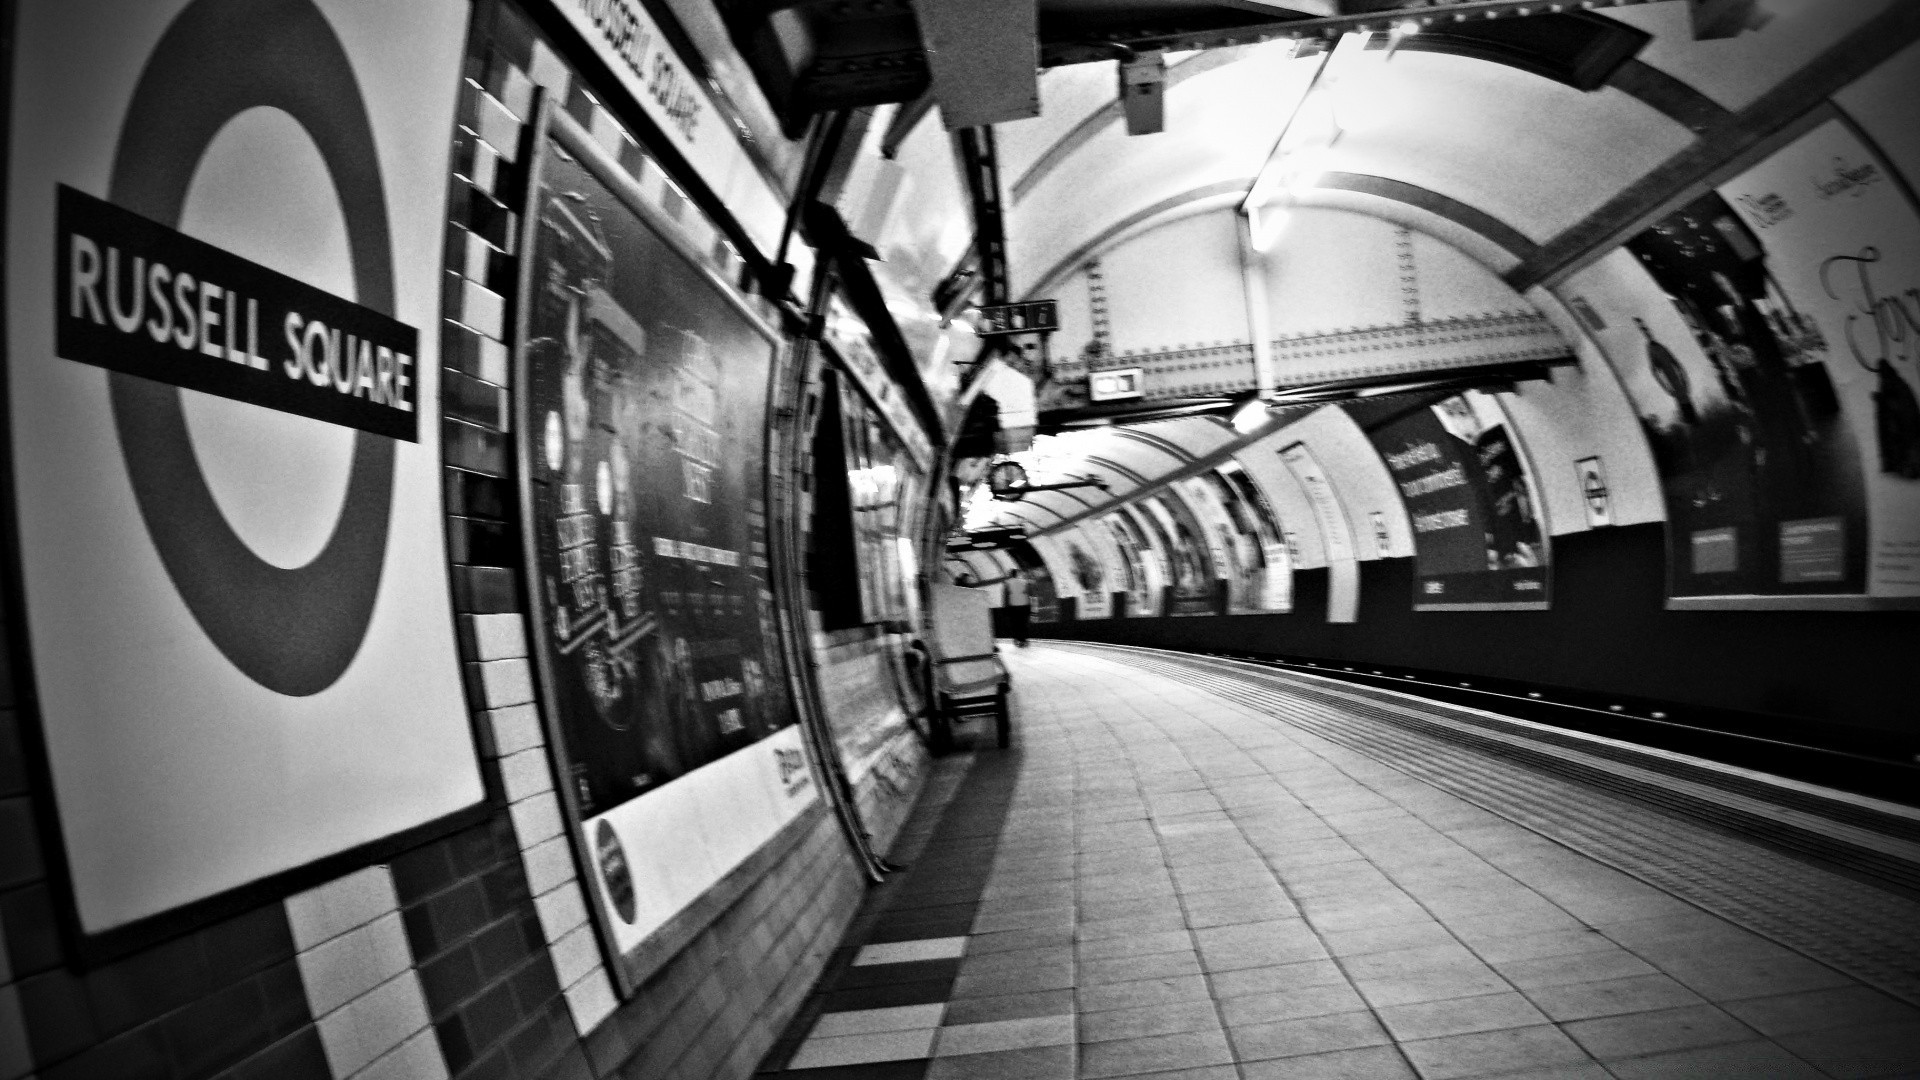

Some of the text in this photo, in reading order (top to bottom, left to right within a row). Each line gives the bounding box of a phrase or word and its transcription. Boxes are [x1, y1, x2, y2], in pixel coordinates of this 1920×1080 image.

[579, 0, 651, 79] USSELL
[71, 232, 414, 412] RUSSELL SQUARE
